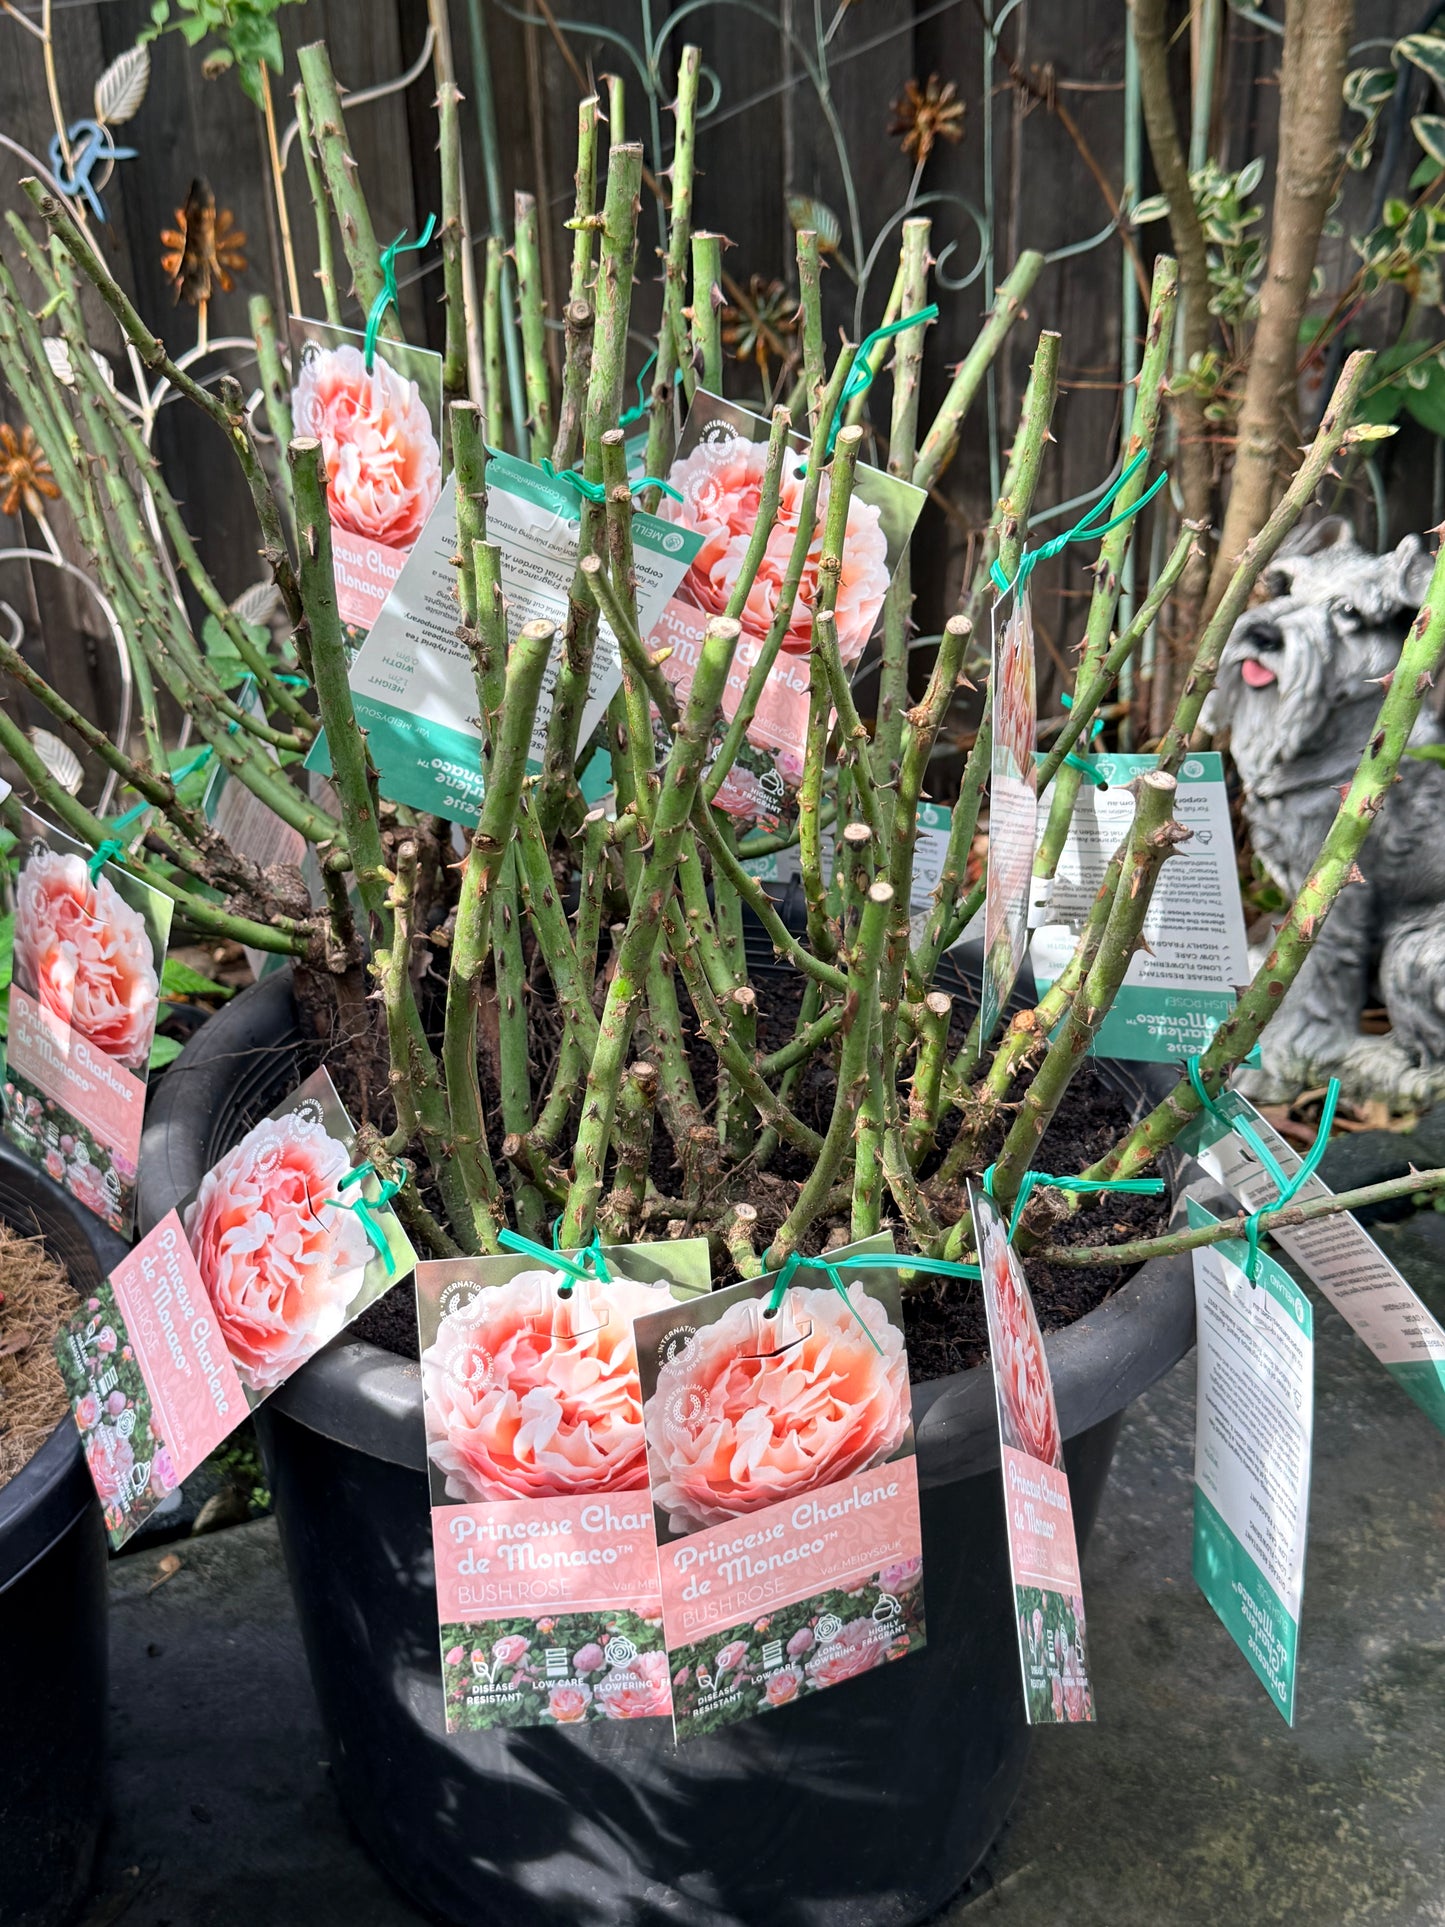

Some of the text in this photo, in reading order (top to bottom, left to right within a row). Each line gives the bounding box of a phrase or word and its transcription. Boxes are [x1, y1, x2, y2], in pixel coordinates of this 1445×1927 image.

[702, 419, 739, 438] INTERNATIO
[520, 528, 549, 550] planting
[631, 522, 663, 542] MEILL
[367, 550, 405, 580] Char
[514, 555, 564, 580] Trial Garden
[517, 567, 562, 589] Fragrance
[646, 577, 659, 589] For
[425, 605, 458, 622] exquisite
[534, 600, 548, 610] cut
[659, 610, 705, 640] rince
[405, 631, 471, 663] grant Hybrid Tea
[422, 628, 459, 649] European
[382, 656, 414, 674] WIDTH
[368, 675, 405, 695] HEIGHT
[355, 704, 412, 731] MEIDYSOUK
[417, 758, 485, 784] onaco™
[742, 790, 782, 814] FRAGRANT
[750, 787, 778, 804] HIGHLY
[1147, 940, 1219, 950] HIGHLY FRAGRA
[1174, 951, 1220, 961] LOW CARE
[1138, 970, 1223, 982] DISEASE RESISTANT
[1143, 960, 1221, 971] LONG FLOWERING
[17, 1024, 33, 1047] de
[74, 1043, 133, 1102] Charlene
[440, 1280, 482, 1304] INTERNATIO
[123, 1270, 161, 1355] BUSH ROSE
[140, 1254, 193, 1378] de Monaco™
[158, 1228, 231, 1417] Princesse Charlene
[657, 1325, 698, 1353] INTERNATIO
[449, 1505, 653, 1544] Princesse Char
[673, 1481, 899, 1574] Princesse Charlene
[458, 1541, 634, 1576] de Monaco™
[681, 1530, 839, 1602] de Monaco™
[820, 1540, 903, 1576] Var. MEIDYSOUK
[459, 1577, 574, 1605] BUSH ROSE
[682, 1575, 787, 1629] BUSH ROSE
[861, 1624, 908, 1648] FRAGRANT
[868, 1619, 900, 1637] HIGHLY
[1241, 1601, 1281, 1672] Charlene
[804, 1645, 857, 1672] FLOWERING
[817, 1643, 843, 1658] LONG
[1276, 1639, 1288, 1667] de
[608, 1671, 638, 1683] LONG
[750, 1660, 798, 1685] LOW CARE
[1248, 1634, 1288, 1703] Princesse
[471, 1682, 515, 1695] DISEASE
[532, 1677, 585, 1691] LOW CARE
[593, 1679, 654, 1693] FLOWERING
[697, 1684, 737, 1706] DISEASE
[466, 1692, 523, 1706] RESISTANT
[693, 1691, 743, 1718] RESISTANT
